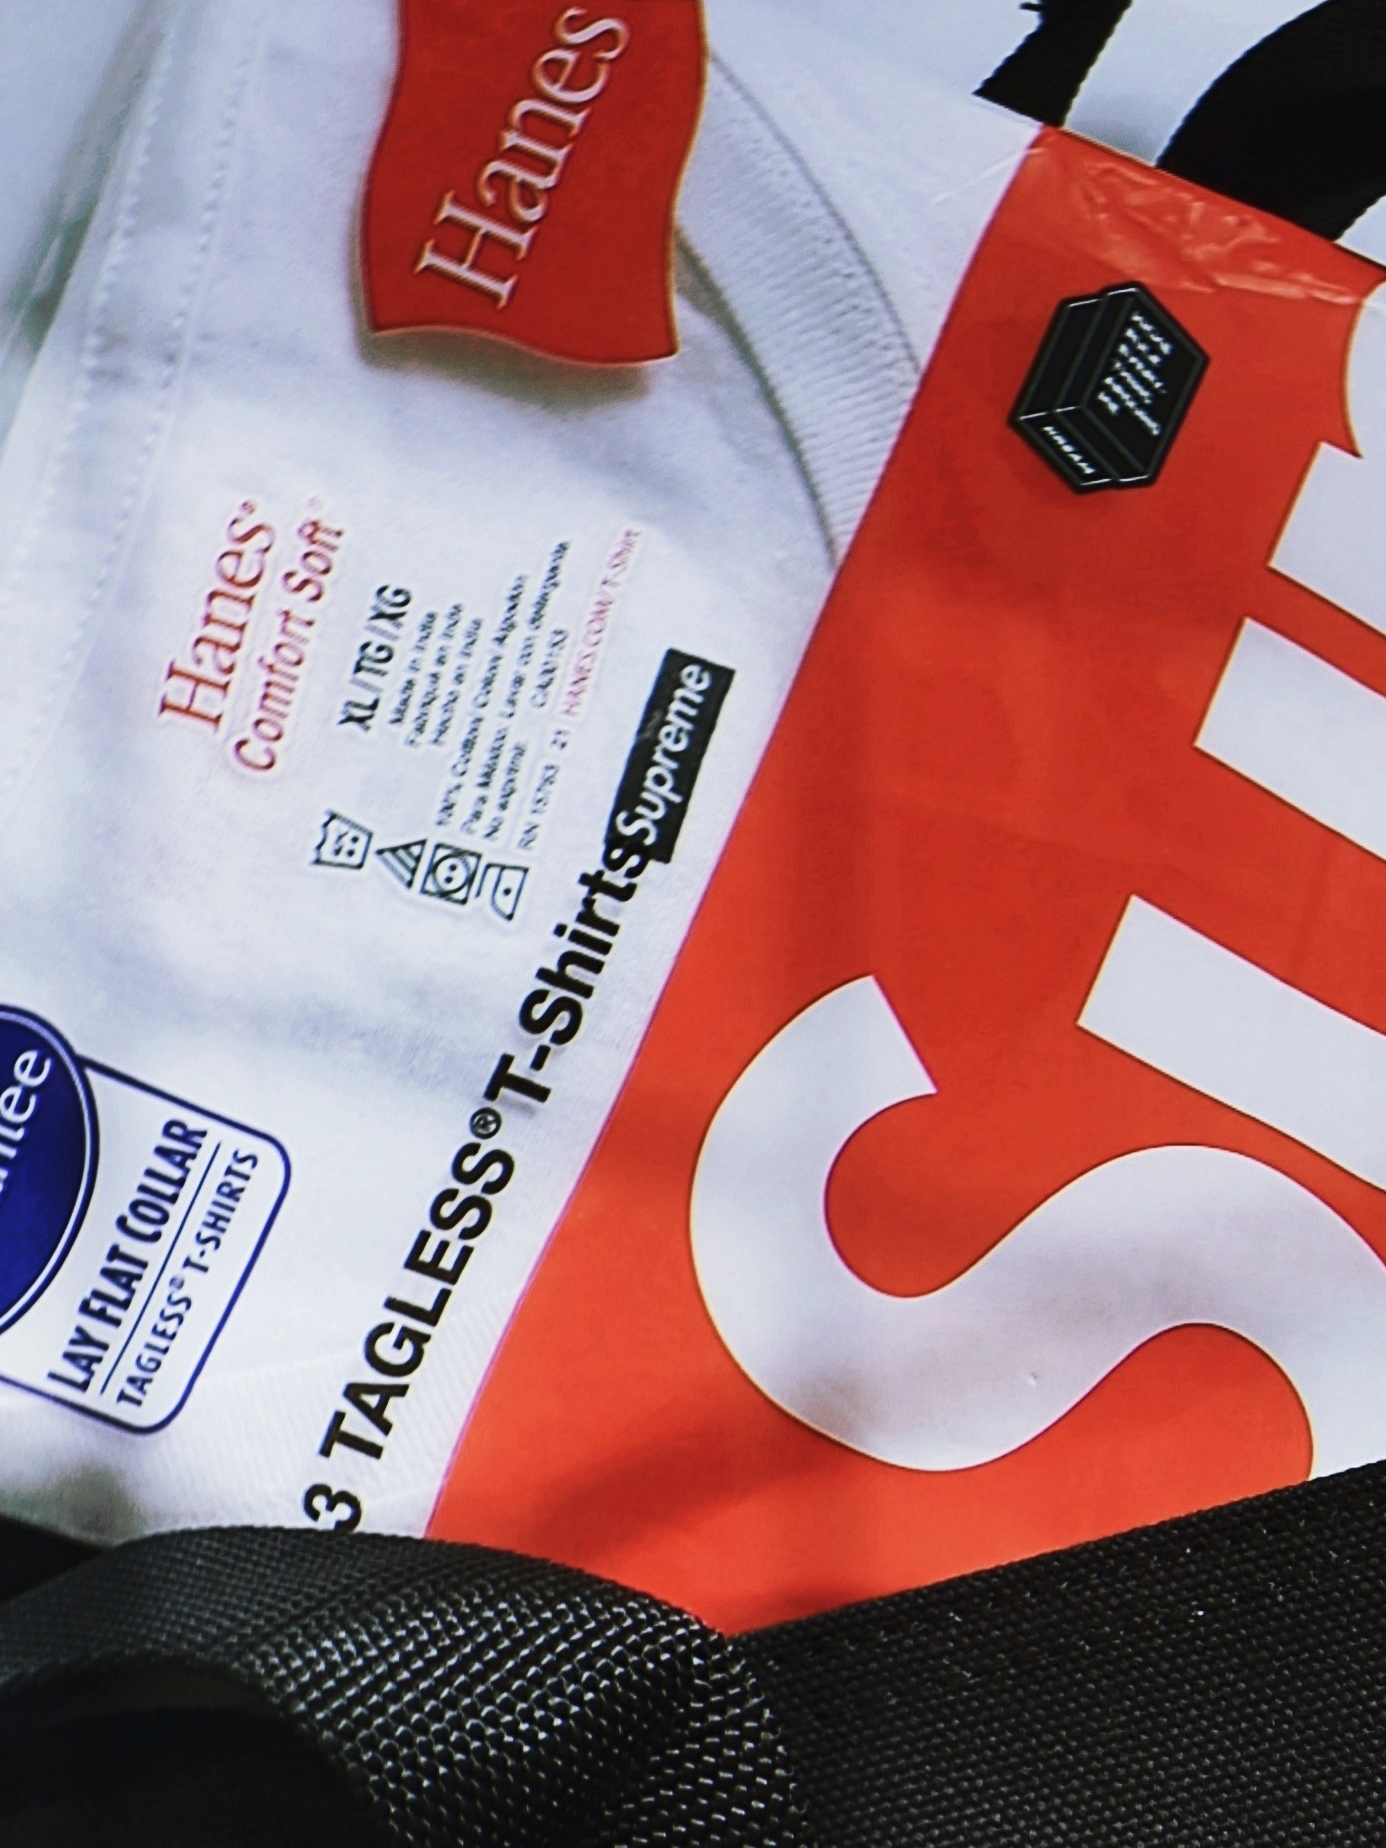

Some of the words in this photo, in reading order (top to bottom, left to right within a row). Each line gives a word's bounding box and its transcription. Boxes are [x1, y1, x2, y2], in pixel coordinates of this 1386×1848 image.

[413, 6, 631, 310] Hanes
[233, 609, 316, 771] Comfort
[615, 663, 712, 846] Supreme
[115, 1119, 207, 1243] COLLAR
[182, 1148, 258, 1273] T-SHIRTS
[304, 1483, 362, 1531] 3
[483, 846, 650, 1103] T-Shirts
[78, 1243, 149, 1328] FLAT
[47, 1324, 110, 1392] LAY
